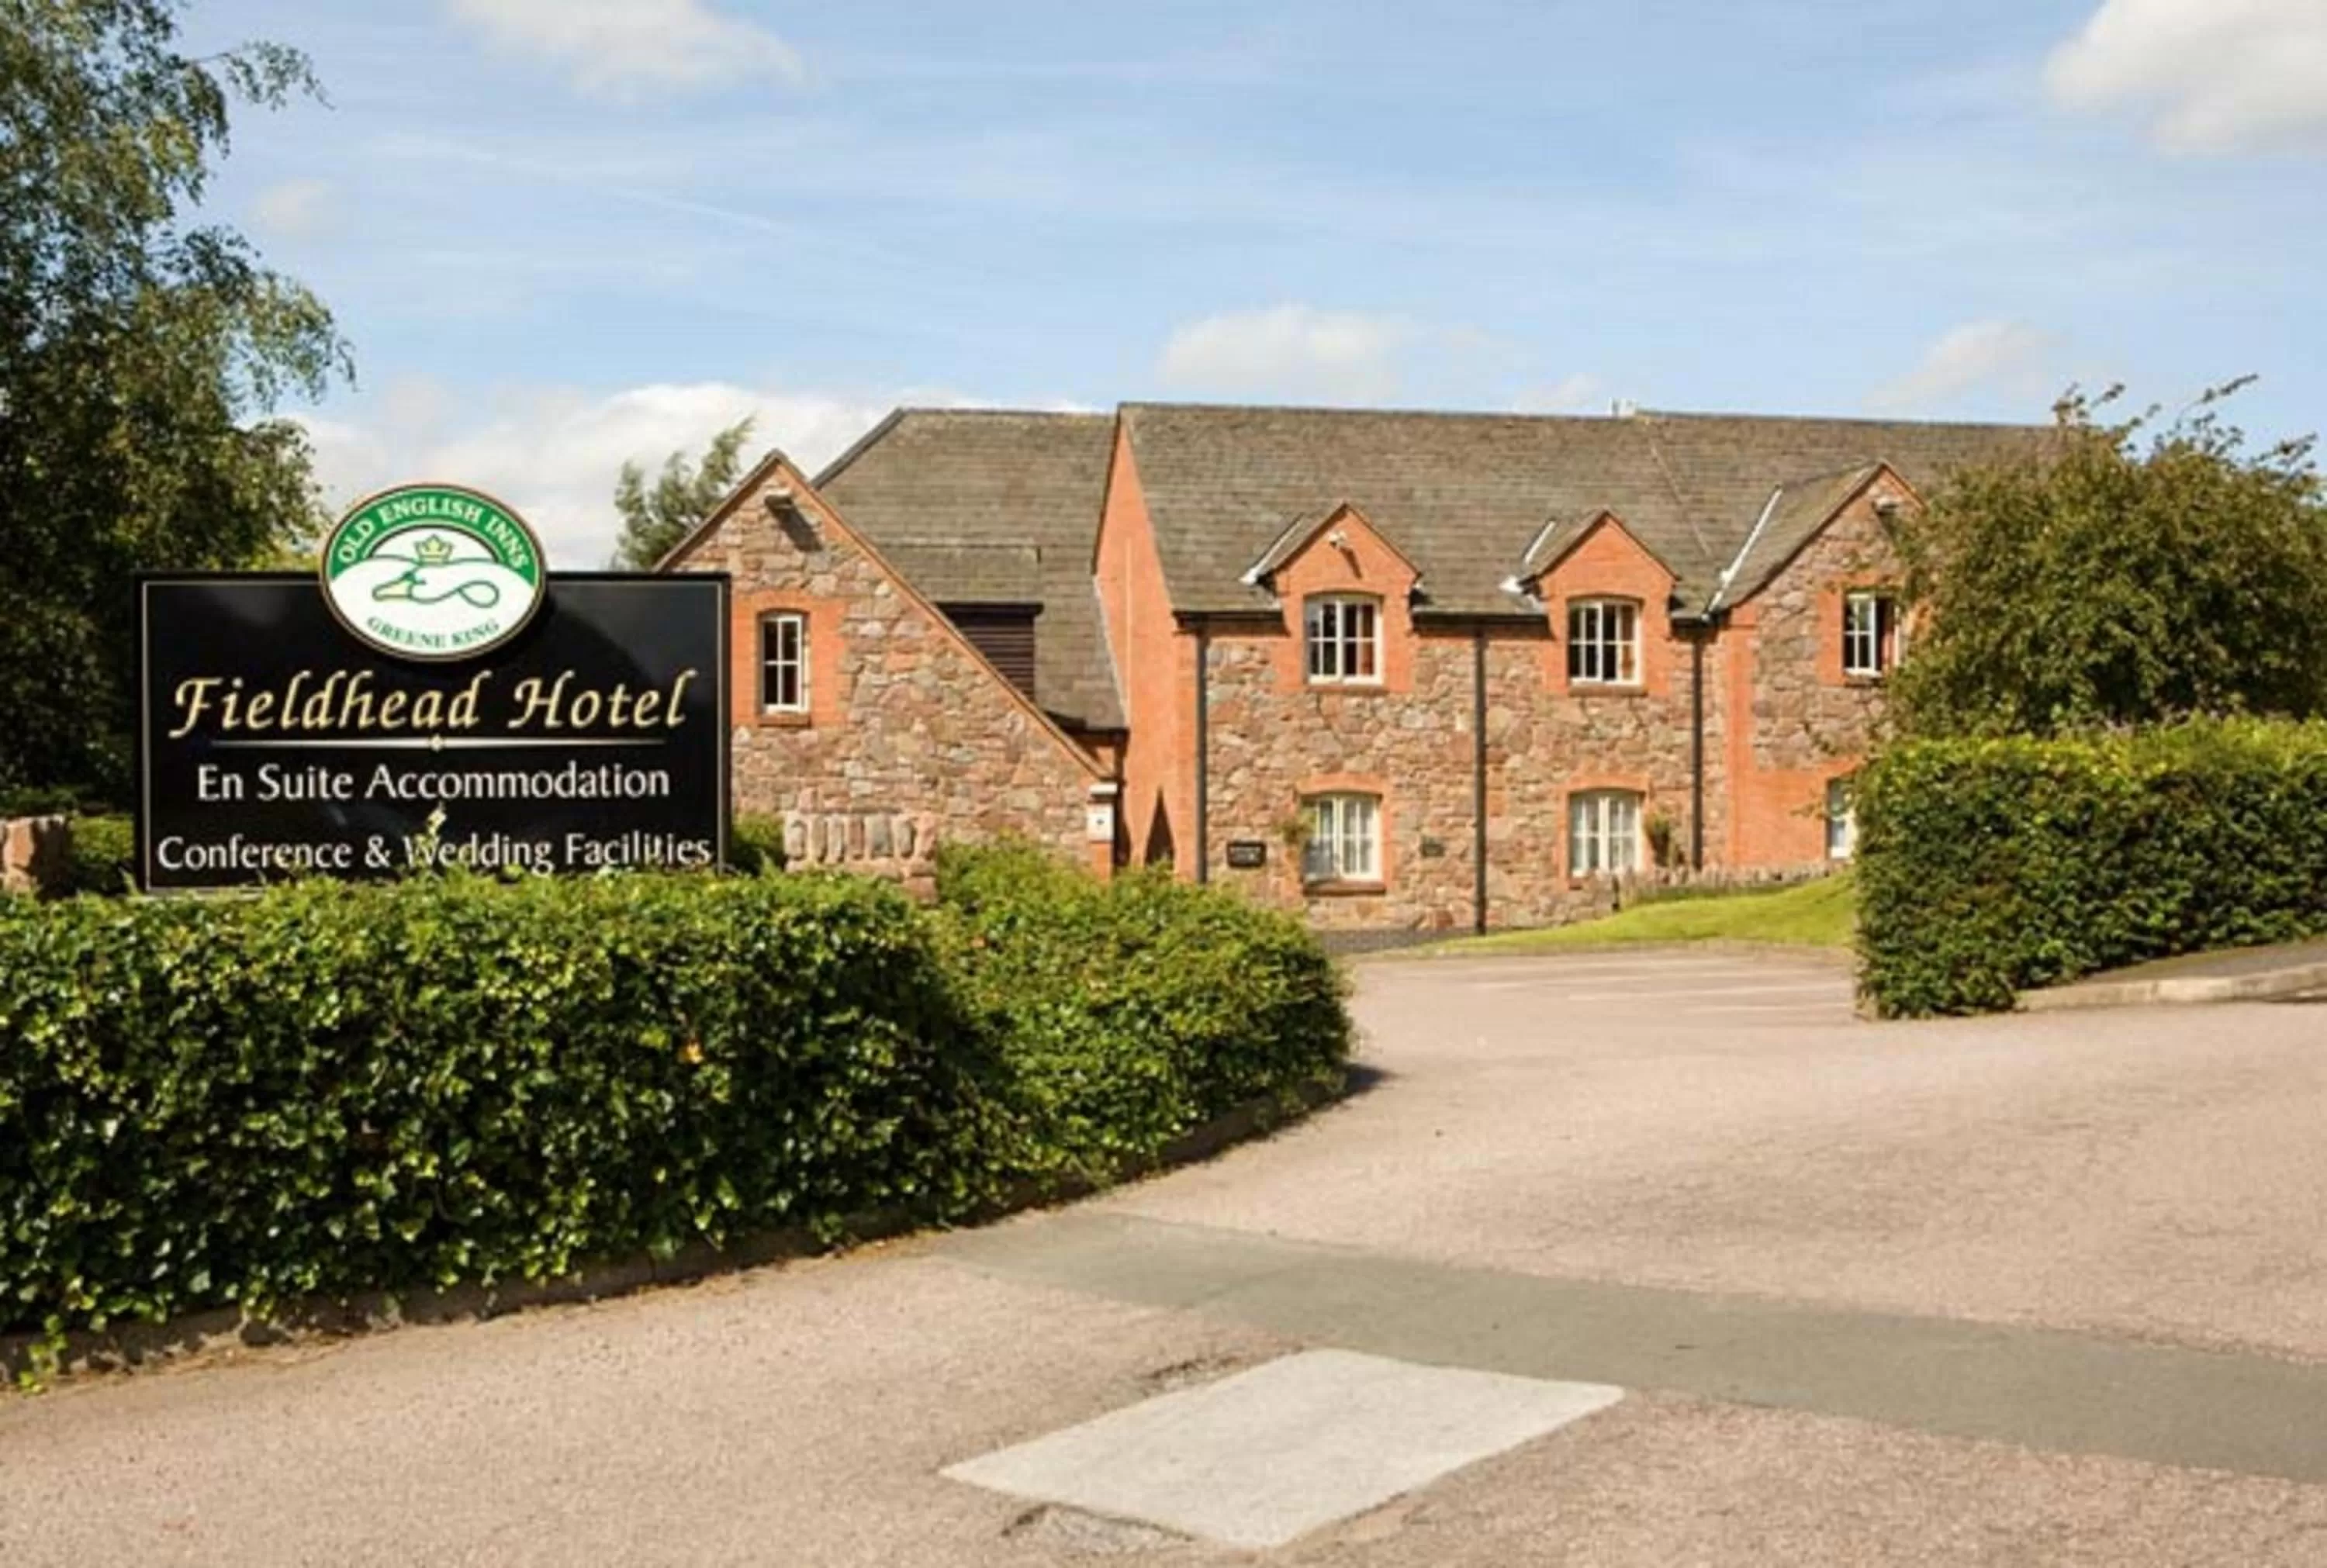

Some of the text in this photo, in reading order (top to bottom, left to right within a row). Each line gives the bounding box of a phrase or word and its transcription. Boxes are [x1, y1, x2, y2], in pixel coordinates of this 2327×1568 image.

[337, 496, 528, 568] OLD ENGLISH INNS
[368, 616, 500, 648] GREENE KING
[168, 668, 698, 737] Fieldhead Hotel
[197, 759, 670, 800] En Suite Accommodation
[157, 830, 713, 878] Conference & Wedding Facilities
